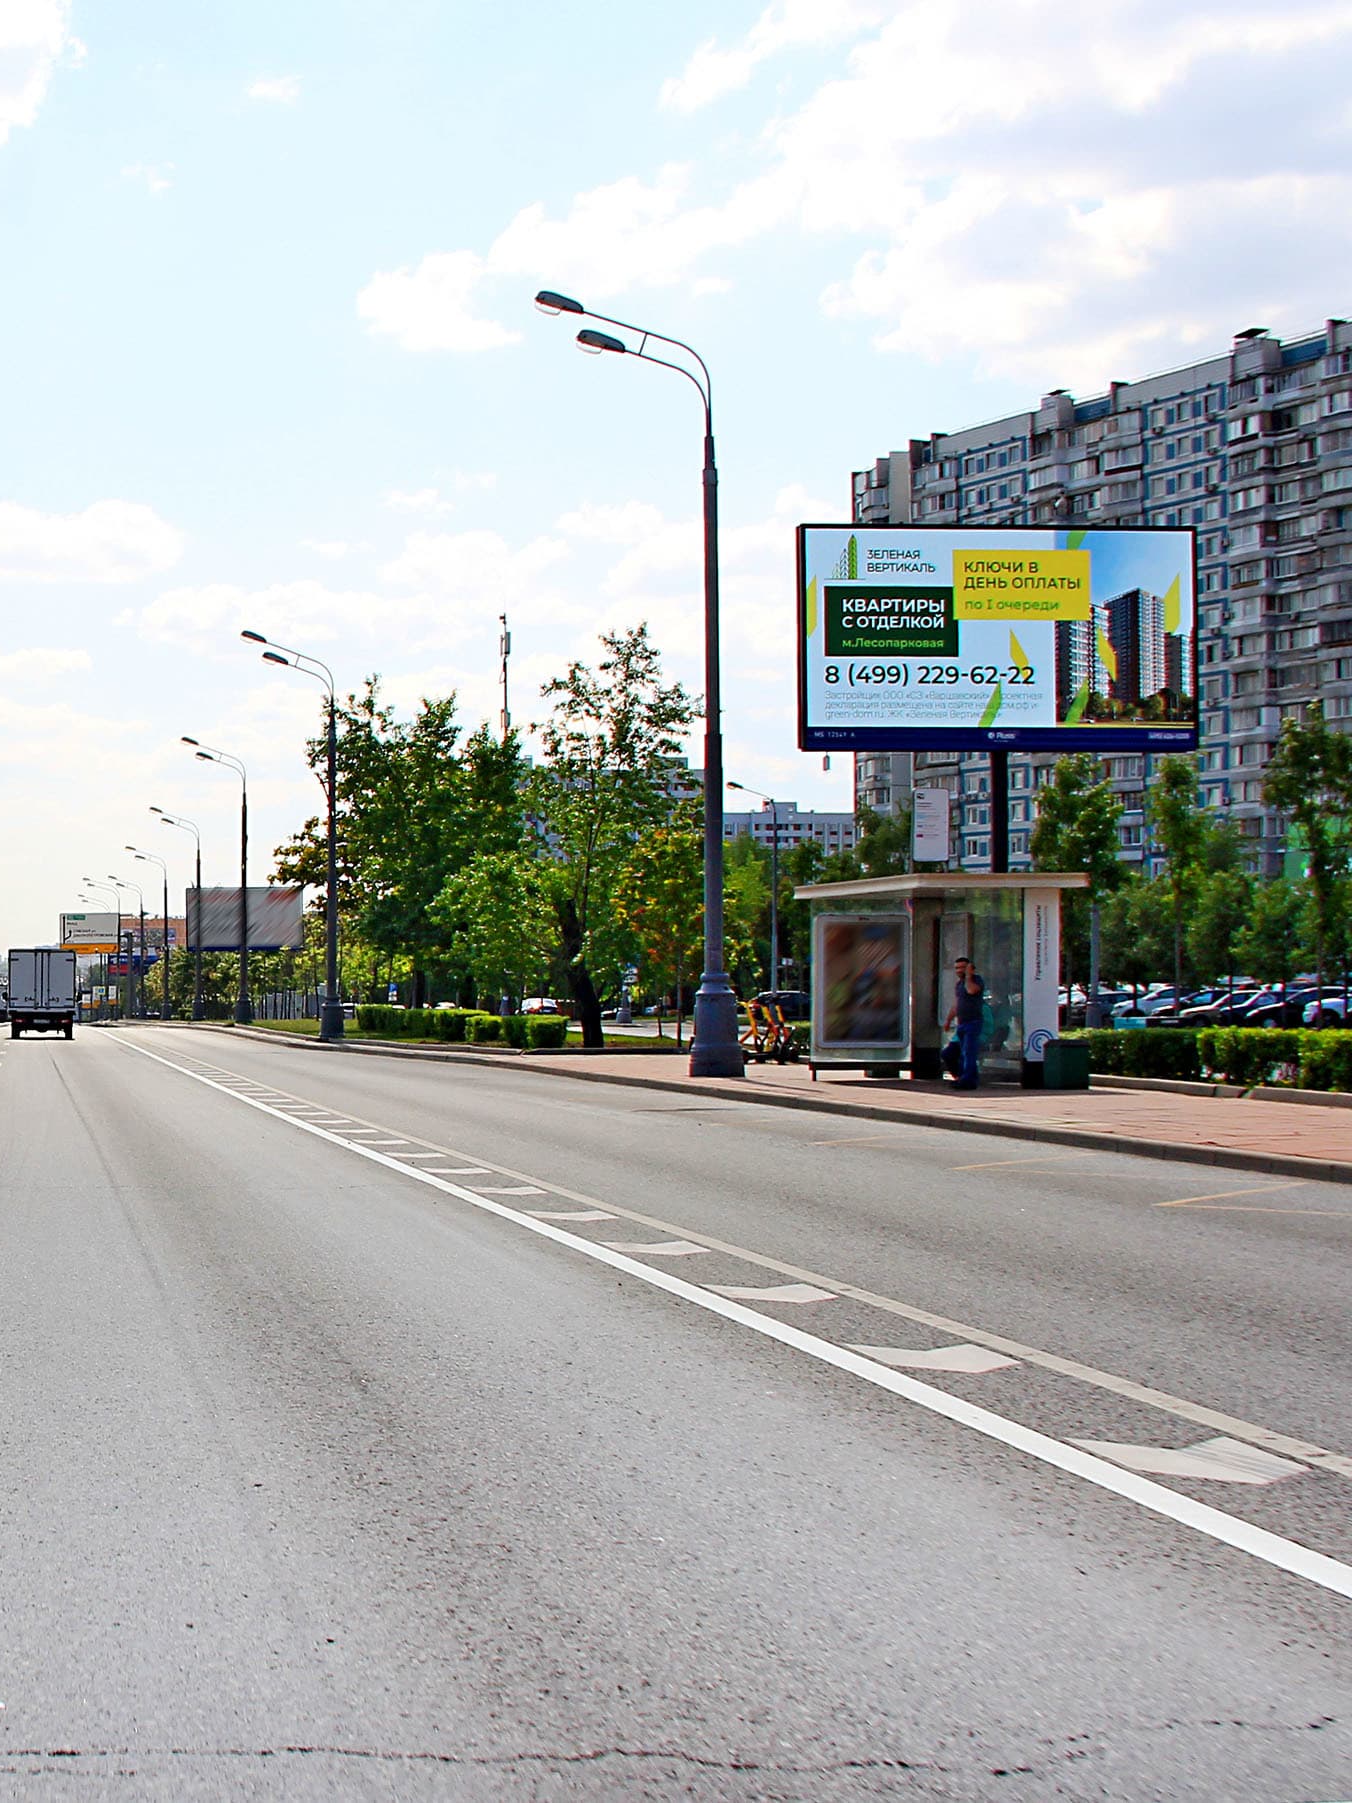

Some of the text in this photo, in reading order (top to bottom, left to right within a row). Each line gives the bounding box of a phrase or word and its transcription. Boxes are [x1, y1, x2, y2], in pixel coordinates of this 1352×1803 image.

[867, 549, 920, 559] ЗЕЛЕНАЯ
[867, 562, 936, 572] ВЕРТИКАЛЬ
[964, 561, 1039, 573] КЛЮЧИ В
[964, 577, 1080, 590] ДЕНЬ ОПЛАТЫ
[842, 599, 944, 613] КВАРТИРЫ
[965, 601, 982, 610] по
[996, 601, 1059, 612] очереди
[842, 614, 944, 630] С ОТДЕЛКОЙ
[842, 638, 944, 649] м.Лесопарковая
[825, 663, 1035, 687] 8 (499) 229-62-22
